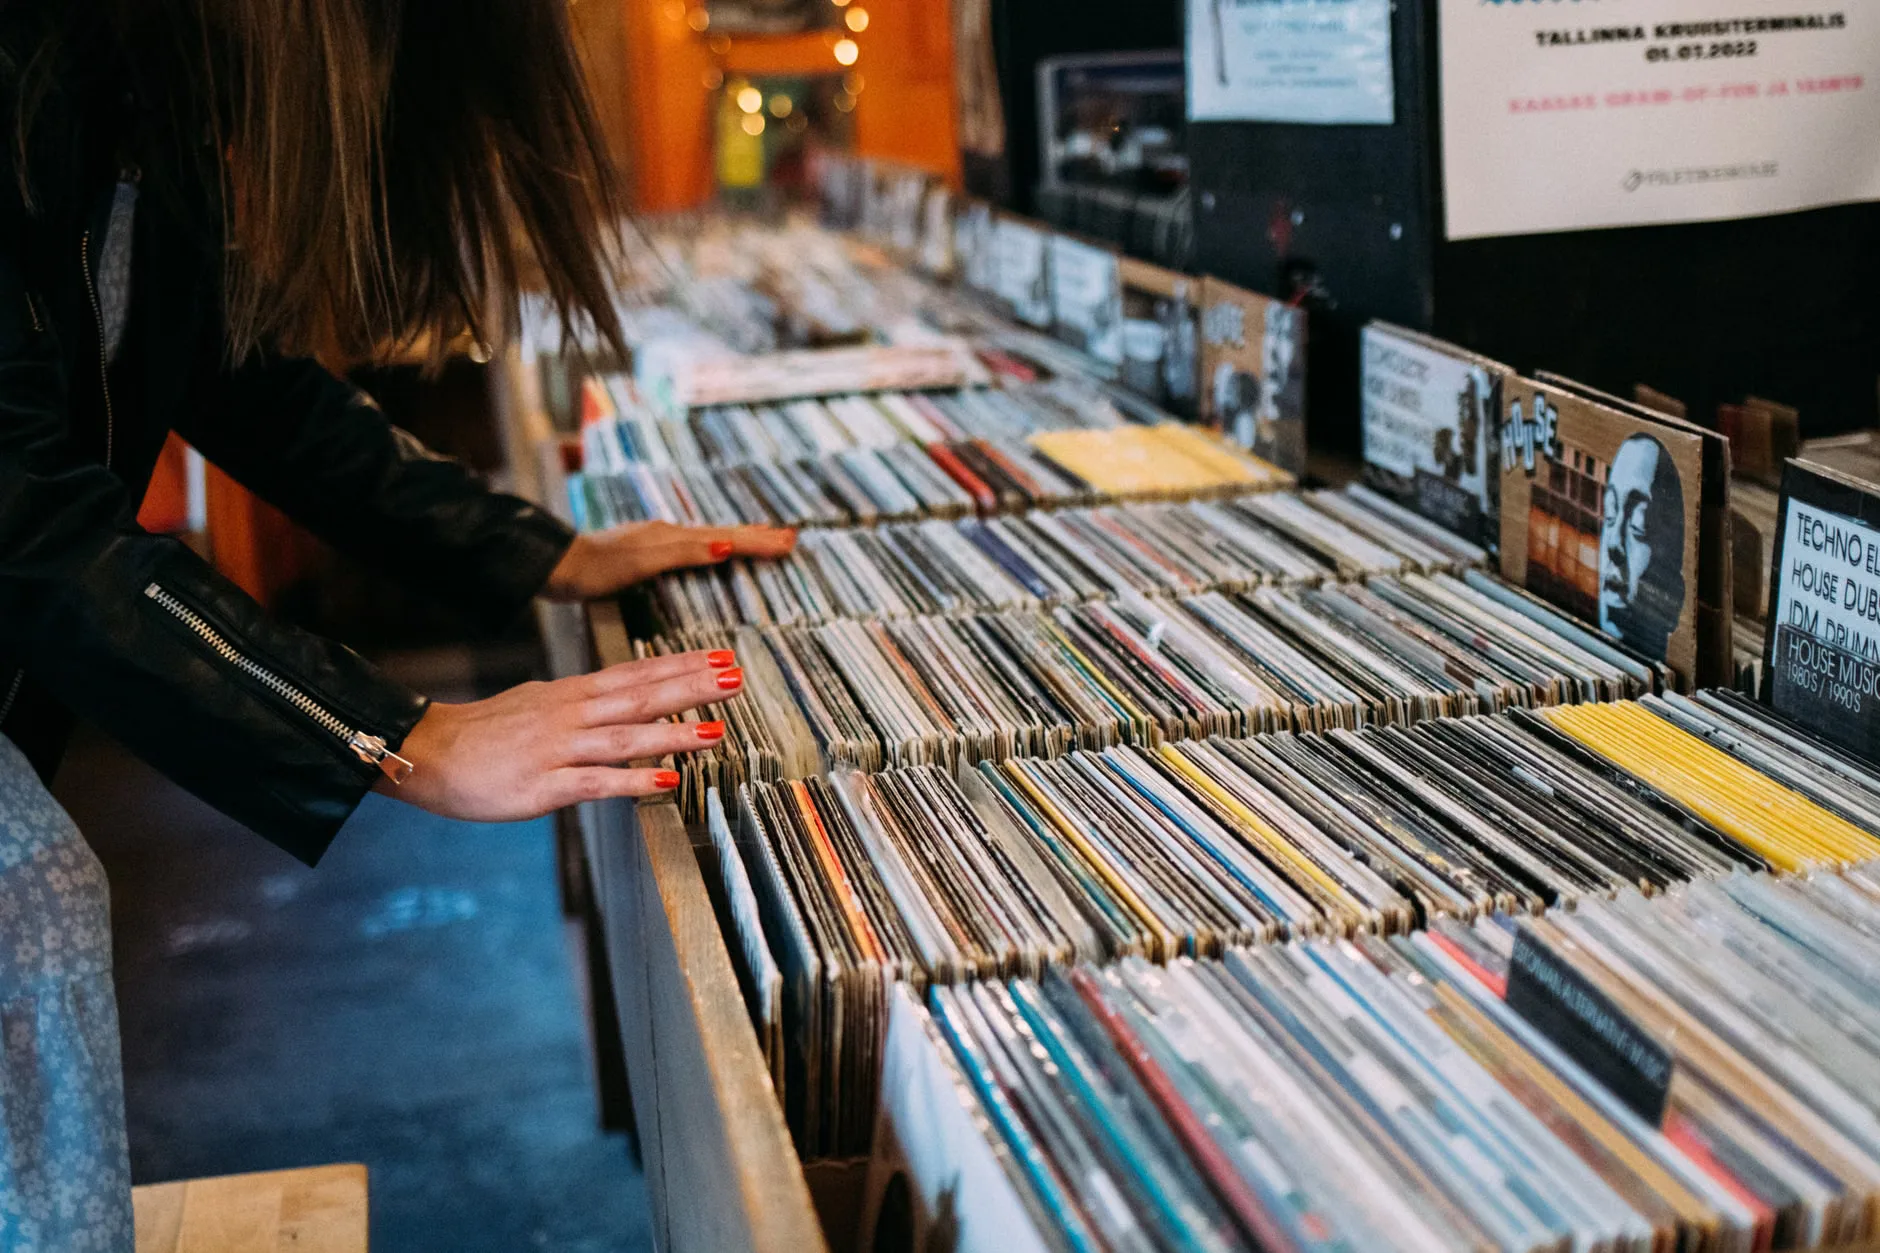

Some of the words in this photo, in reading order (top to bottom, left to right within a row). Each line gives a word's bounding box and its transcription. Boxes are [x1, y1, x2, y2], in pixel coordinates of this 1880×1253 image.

[1535, 25, 1645, 47] TALLINNA
[1645, 41, 1758, 62] 01.07.2022
[1797, 512, 1862, 567] TECHNO
[1792, 557, 1838, 604] HOUSE
[1789, 597, 1819, 634] IDM
[1789, 633, 1836, 678] HOUSE
